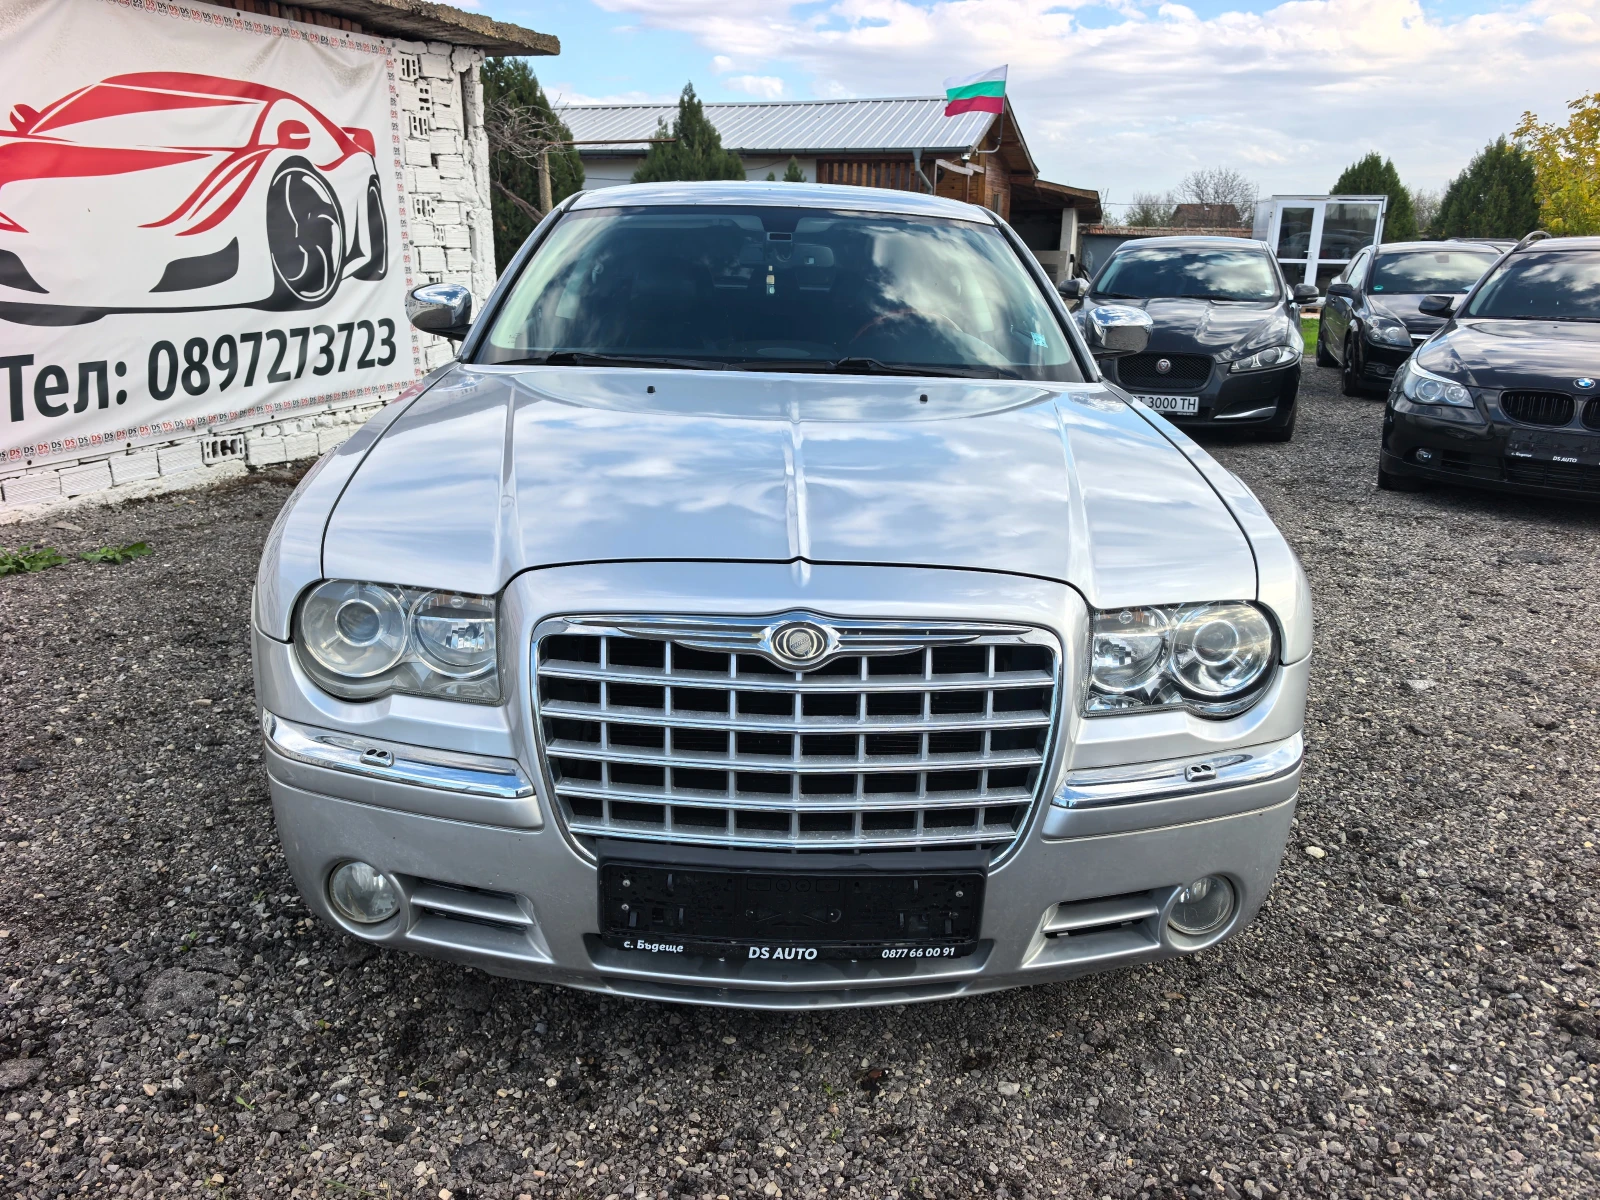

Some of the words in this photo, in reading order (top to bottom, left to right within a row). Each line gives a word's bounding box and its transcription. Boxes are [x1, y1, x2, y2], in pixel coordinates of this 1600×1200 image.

[0, 354, 127, 422] Тел:
[148, 318, 396, 401] 0897273723
[1147, 397, 1177, 409] 3000
[1180, 398, 1196, 410] TH
[636, 940, 684, 953] Бъдеще
[882, 949, 908, 958] 0877
[910, 949, 923, 957] 66
[926, 948, 940, 956] 00
[943, 947, 955, 956] 91
[748, 947, 770, 958] DS
[772, 948, 817, 960] AUTO
